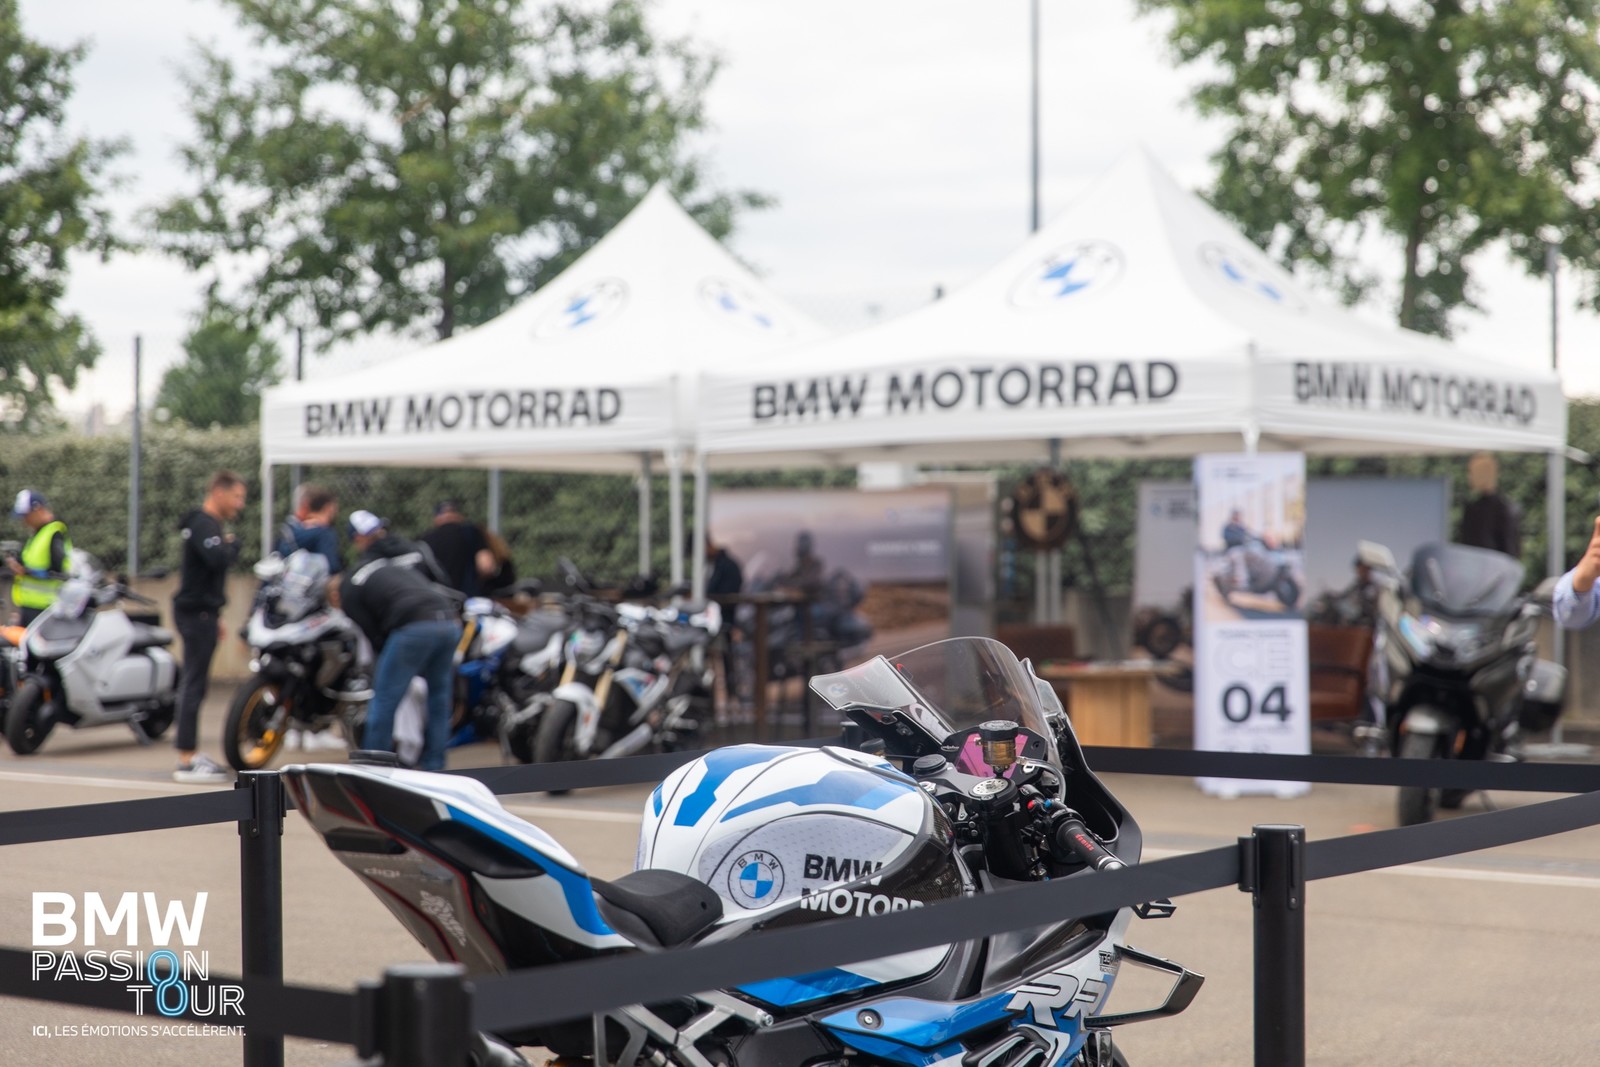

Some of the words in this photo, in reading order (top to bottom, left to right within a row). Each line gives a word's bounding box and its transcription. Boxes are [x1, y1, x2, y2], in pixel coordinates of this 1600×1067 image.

[306, 397, 391, 436] BMW
[404, 387, 622, 434] MOTORRAD
[753, 376, 867, 420] BMW
[887, 361, 1179, 415] MOTORRAD
[1293, 361, 1370, 408] BMW
[1382, 368, 1537, 427] MOTORRAD
[1221, 682, 1292, 725] 04
[804, 854, 882, 886] BMW
